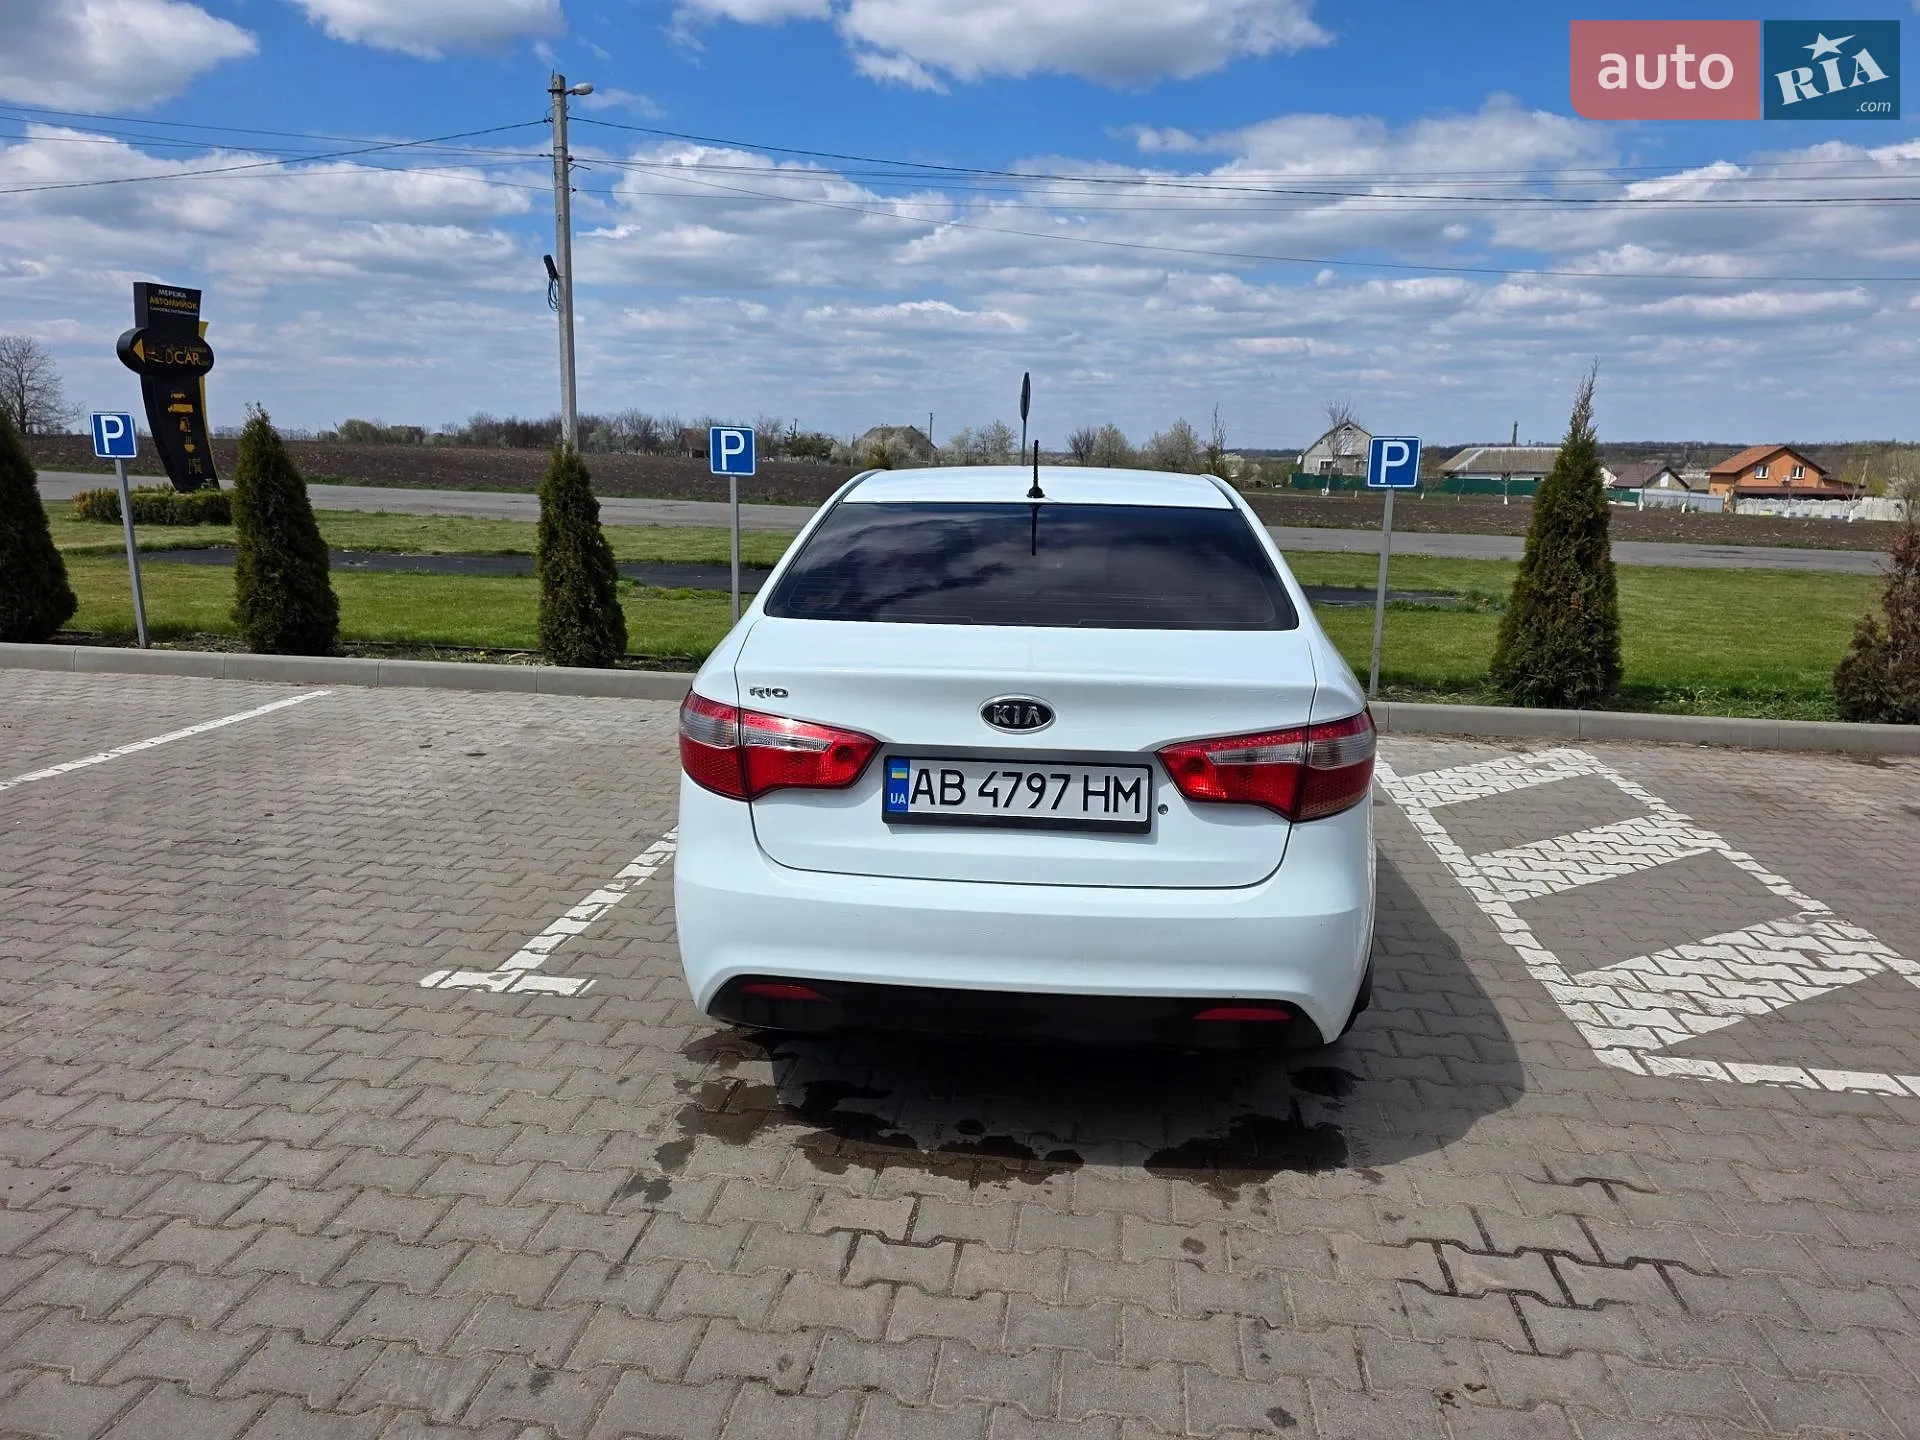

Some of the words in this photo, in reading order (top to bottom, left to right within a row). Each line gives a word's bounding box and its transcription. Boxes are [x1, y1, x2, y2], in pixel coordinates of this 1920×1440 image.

[158, 288, 187, 299] МЕРЕЖА
[100, 415, 124, 454] P
[720, 430, 745, 471] P
[1380, 441, 1410, 484] P
[749, 687, 789, 699] RIO
[991, 704, 1043, 726] KIA
[890, 792, 907, 805] UA
[910, 768, 966, 806] AB
[977, 771, 1072, 810] 4797
[1082, 774, 1141, 814] HM
